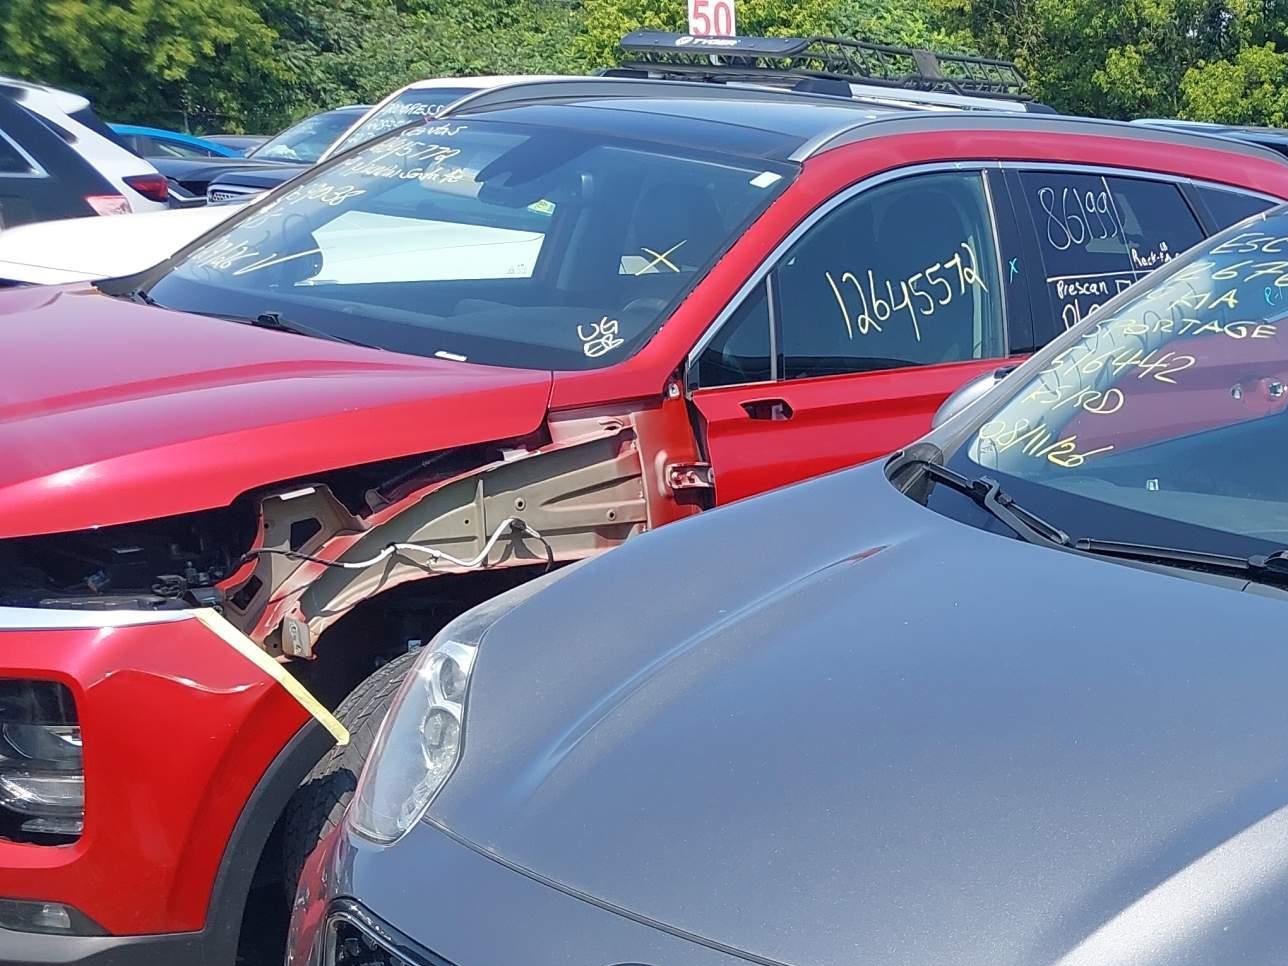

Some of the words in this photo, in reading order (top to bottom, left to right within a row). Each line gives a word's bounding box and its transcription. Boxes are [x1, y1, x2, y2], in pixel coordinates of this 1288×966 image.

[692, 0, 732, 37] 50
[825, 242, 989, 342] 12645572
[1081, 317, 1280, 340] SPORTAGE
